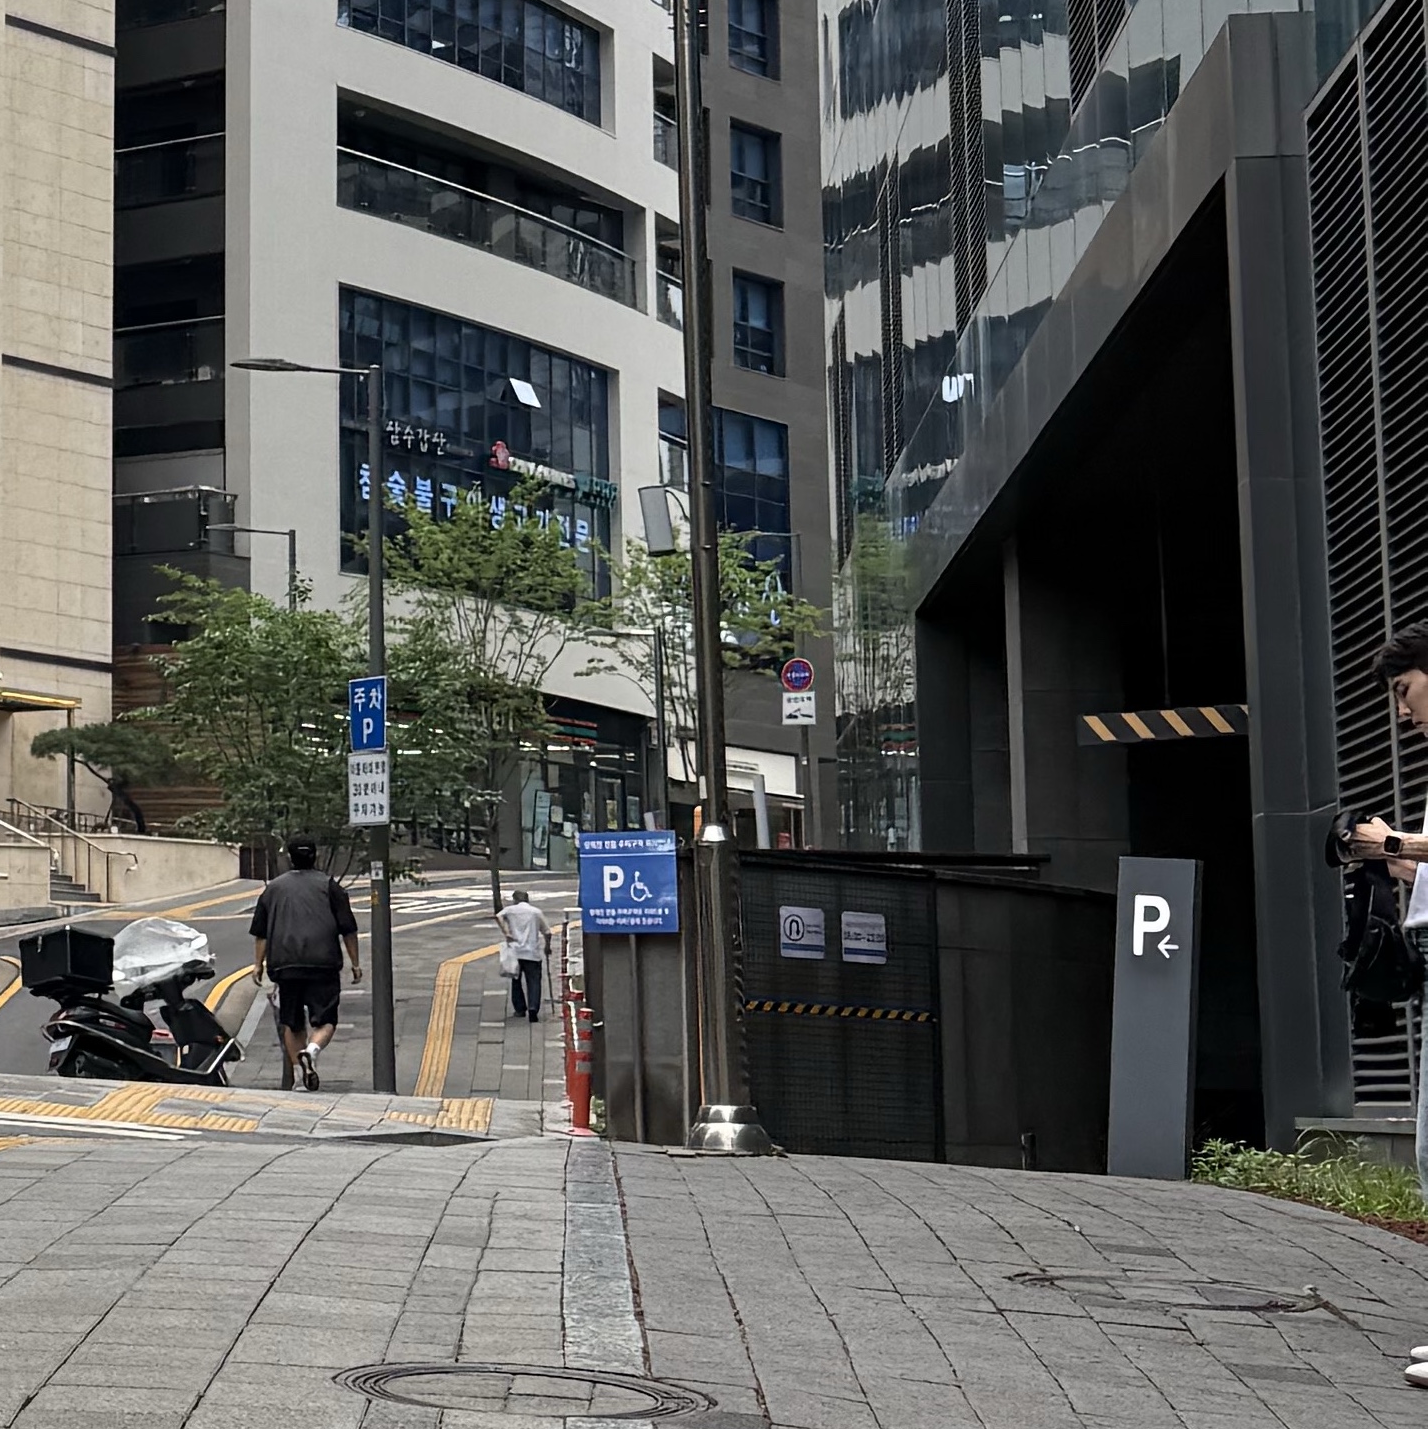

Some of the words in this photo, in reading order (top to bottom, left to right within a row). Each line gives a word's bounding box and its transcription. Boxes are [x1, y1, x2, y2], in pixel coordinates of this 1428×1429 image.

[353, 685, 383, 713] 주차
[362, 717, 374, 744] P
[603, 865, 625, 903] P
[1132, 893, 1172, 956] P
